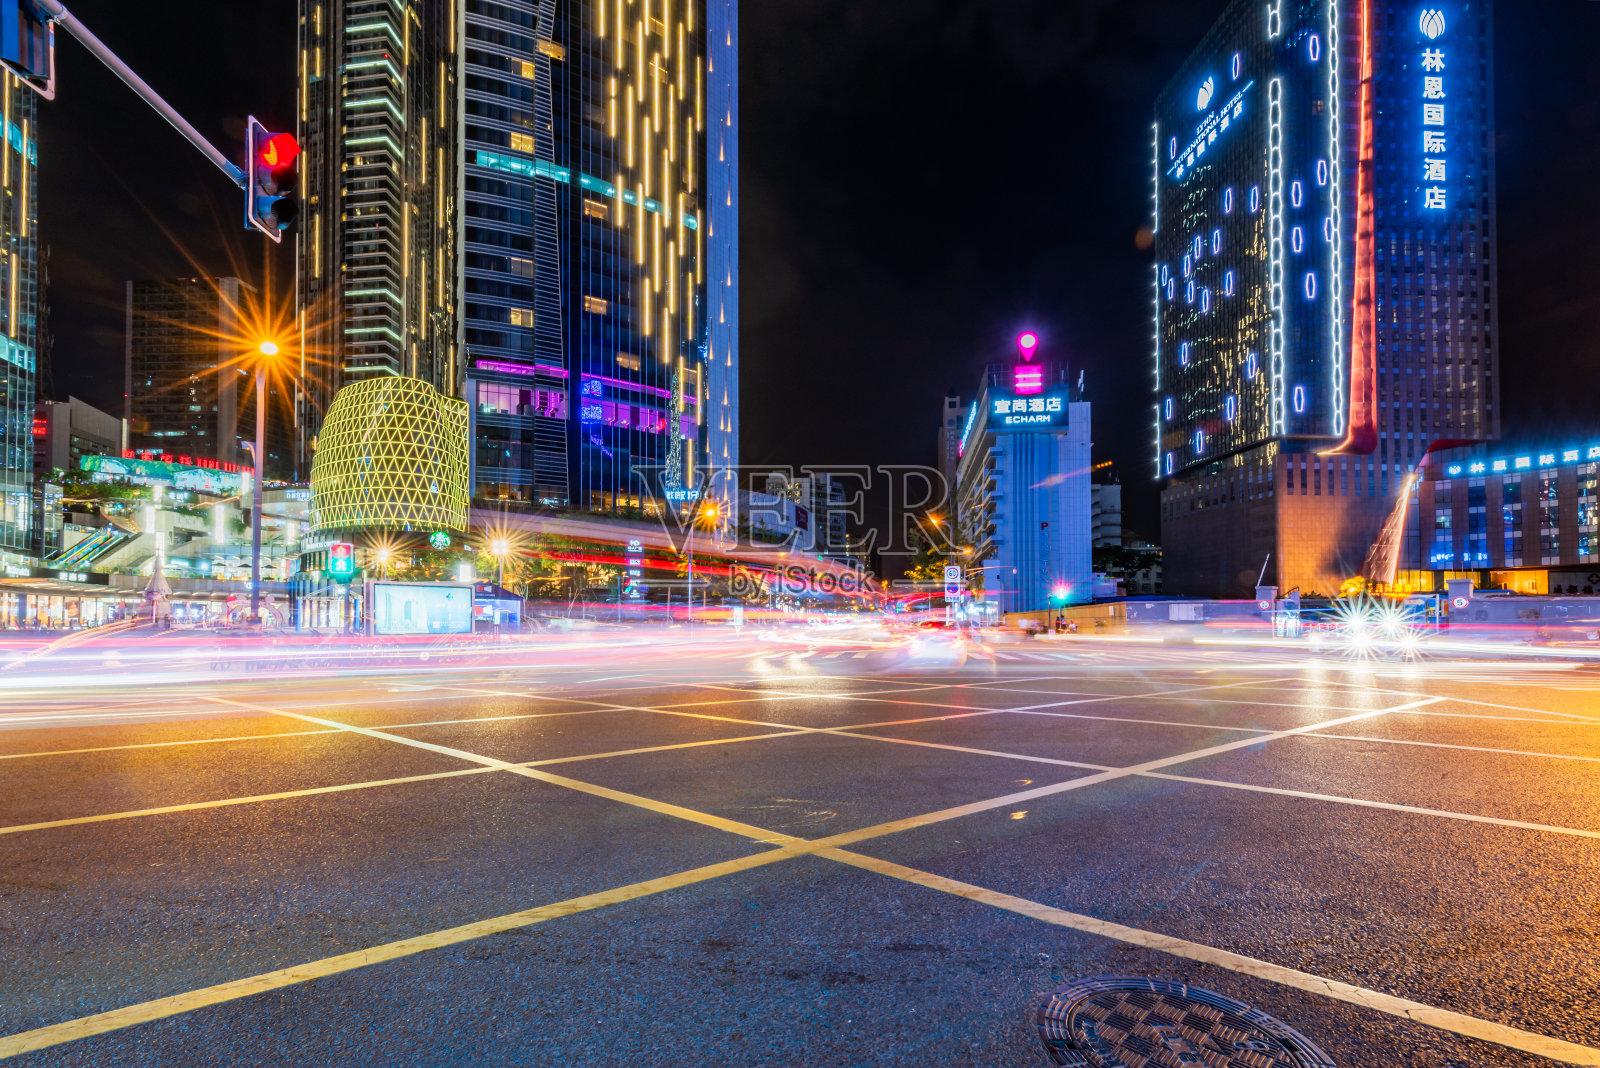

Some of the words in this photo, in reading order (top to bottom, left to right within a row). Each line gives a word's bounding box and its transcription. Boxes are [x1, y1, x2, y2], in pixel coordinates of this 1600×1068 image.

[1173, 115, 1221, 168] INTERNATIONAL
[1220, 91, 1243, 119] HOTEL
[1421, 48, 1447, 210] 林恩国际酒店
[1176, 100, 1243, 179] 林恩国际酒店
[994, 397, 1061, 414] 宜尚酒店
[1005, 415, 1051, 424] ECHARM
[196, 457, 220, 470] HOME
[1041, 522, 1049, 530] P
